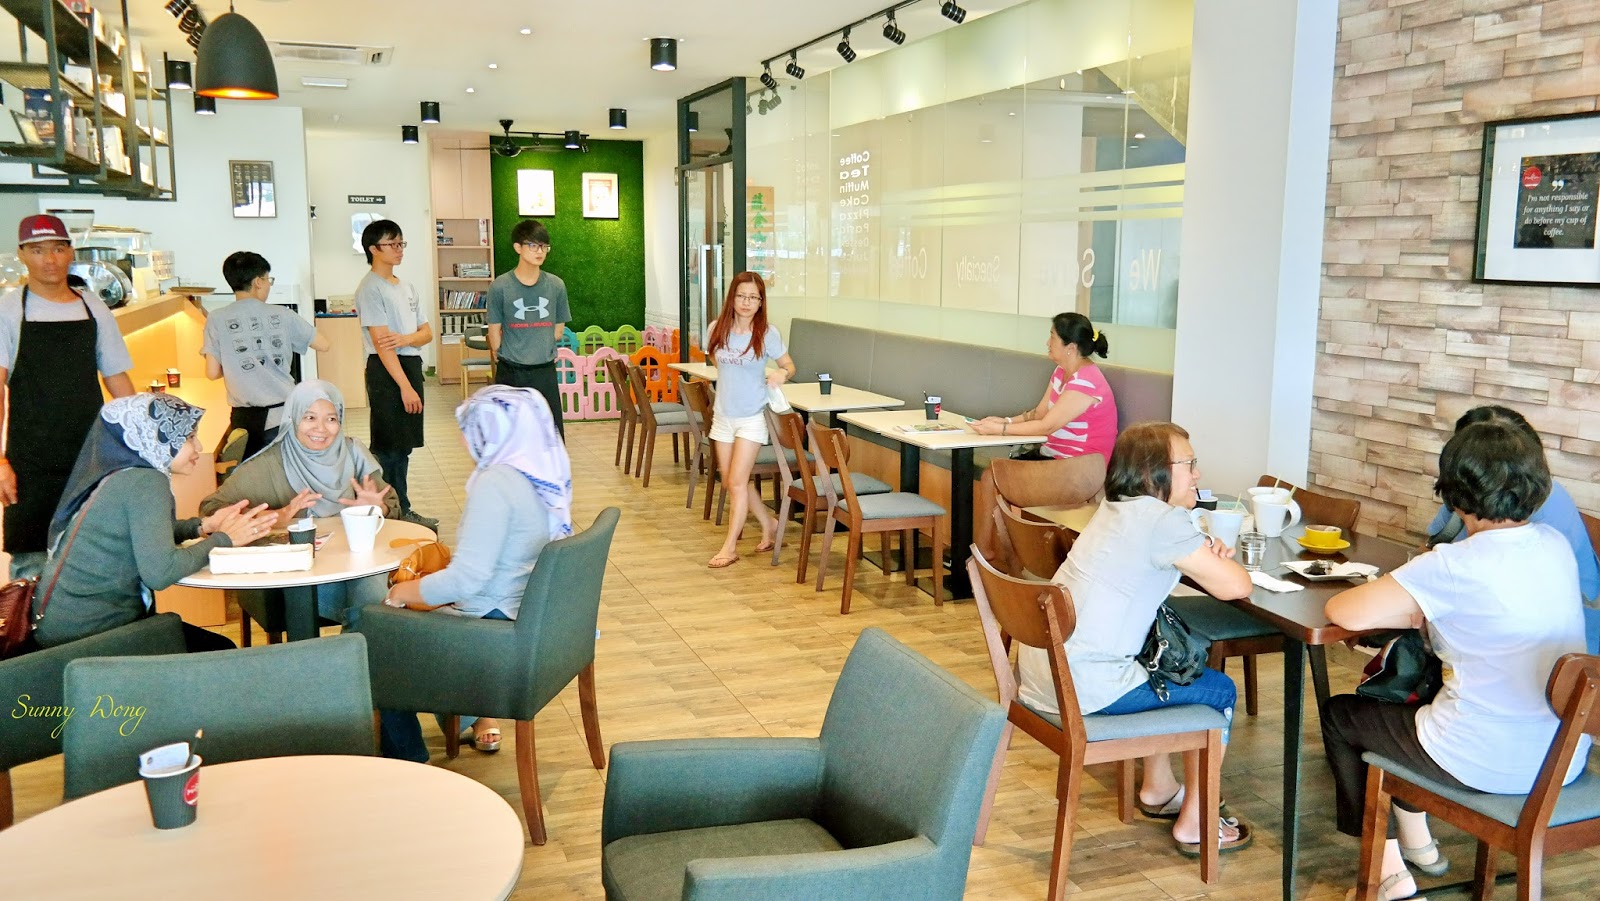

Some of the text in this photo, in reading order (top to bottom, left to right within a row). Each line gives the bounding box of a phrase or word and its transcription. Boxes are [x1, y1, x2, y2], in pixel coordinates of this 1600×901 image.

[1551, 192, 1589, 203] responsible
[1522, 205, 1533, 215] for
[1534, 204, 1564, 214] anything
[1569, 205, 1580, 213] say
[1533, 216, 1553, 226] before
[1566, 217, 1579, 225] cup
[1580, 215, 1588, 225] of
[1543, 227, 1565, 237] coffee.
